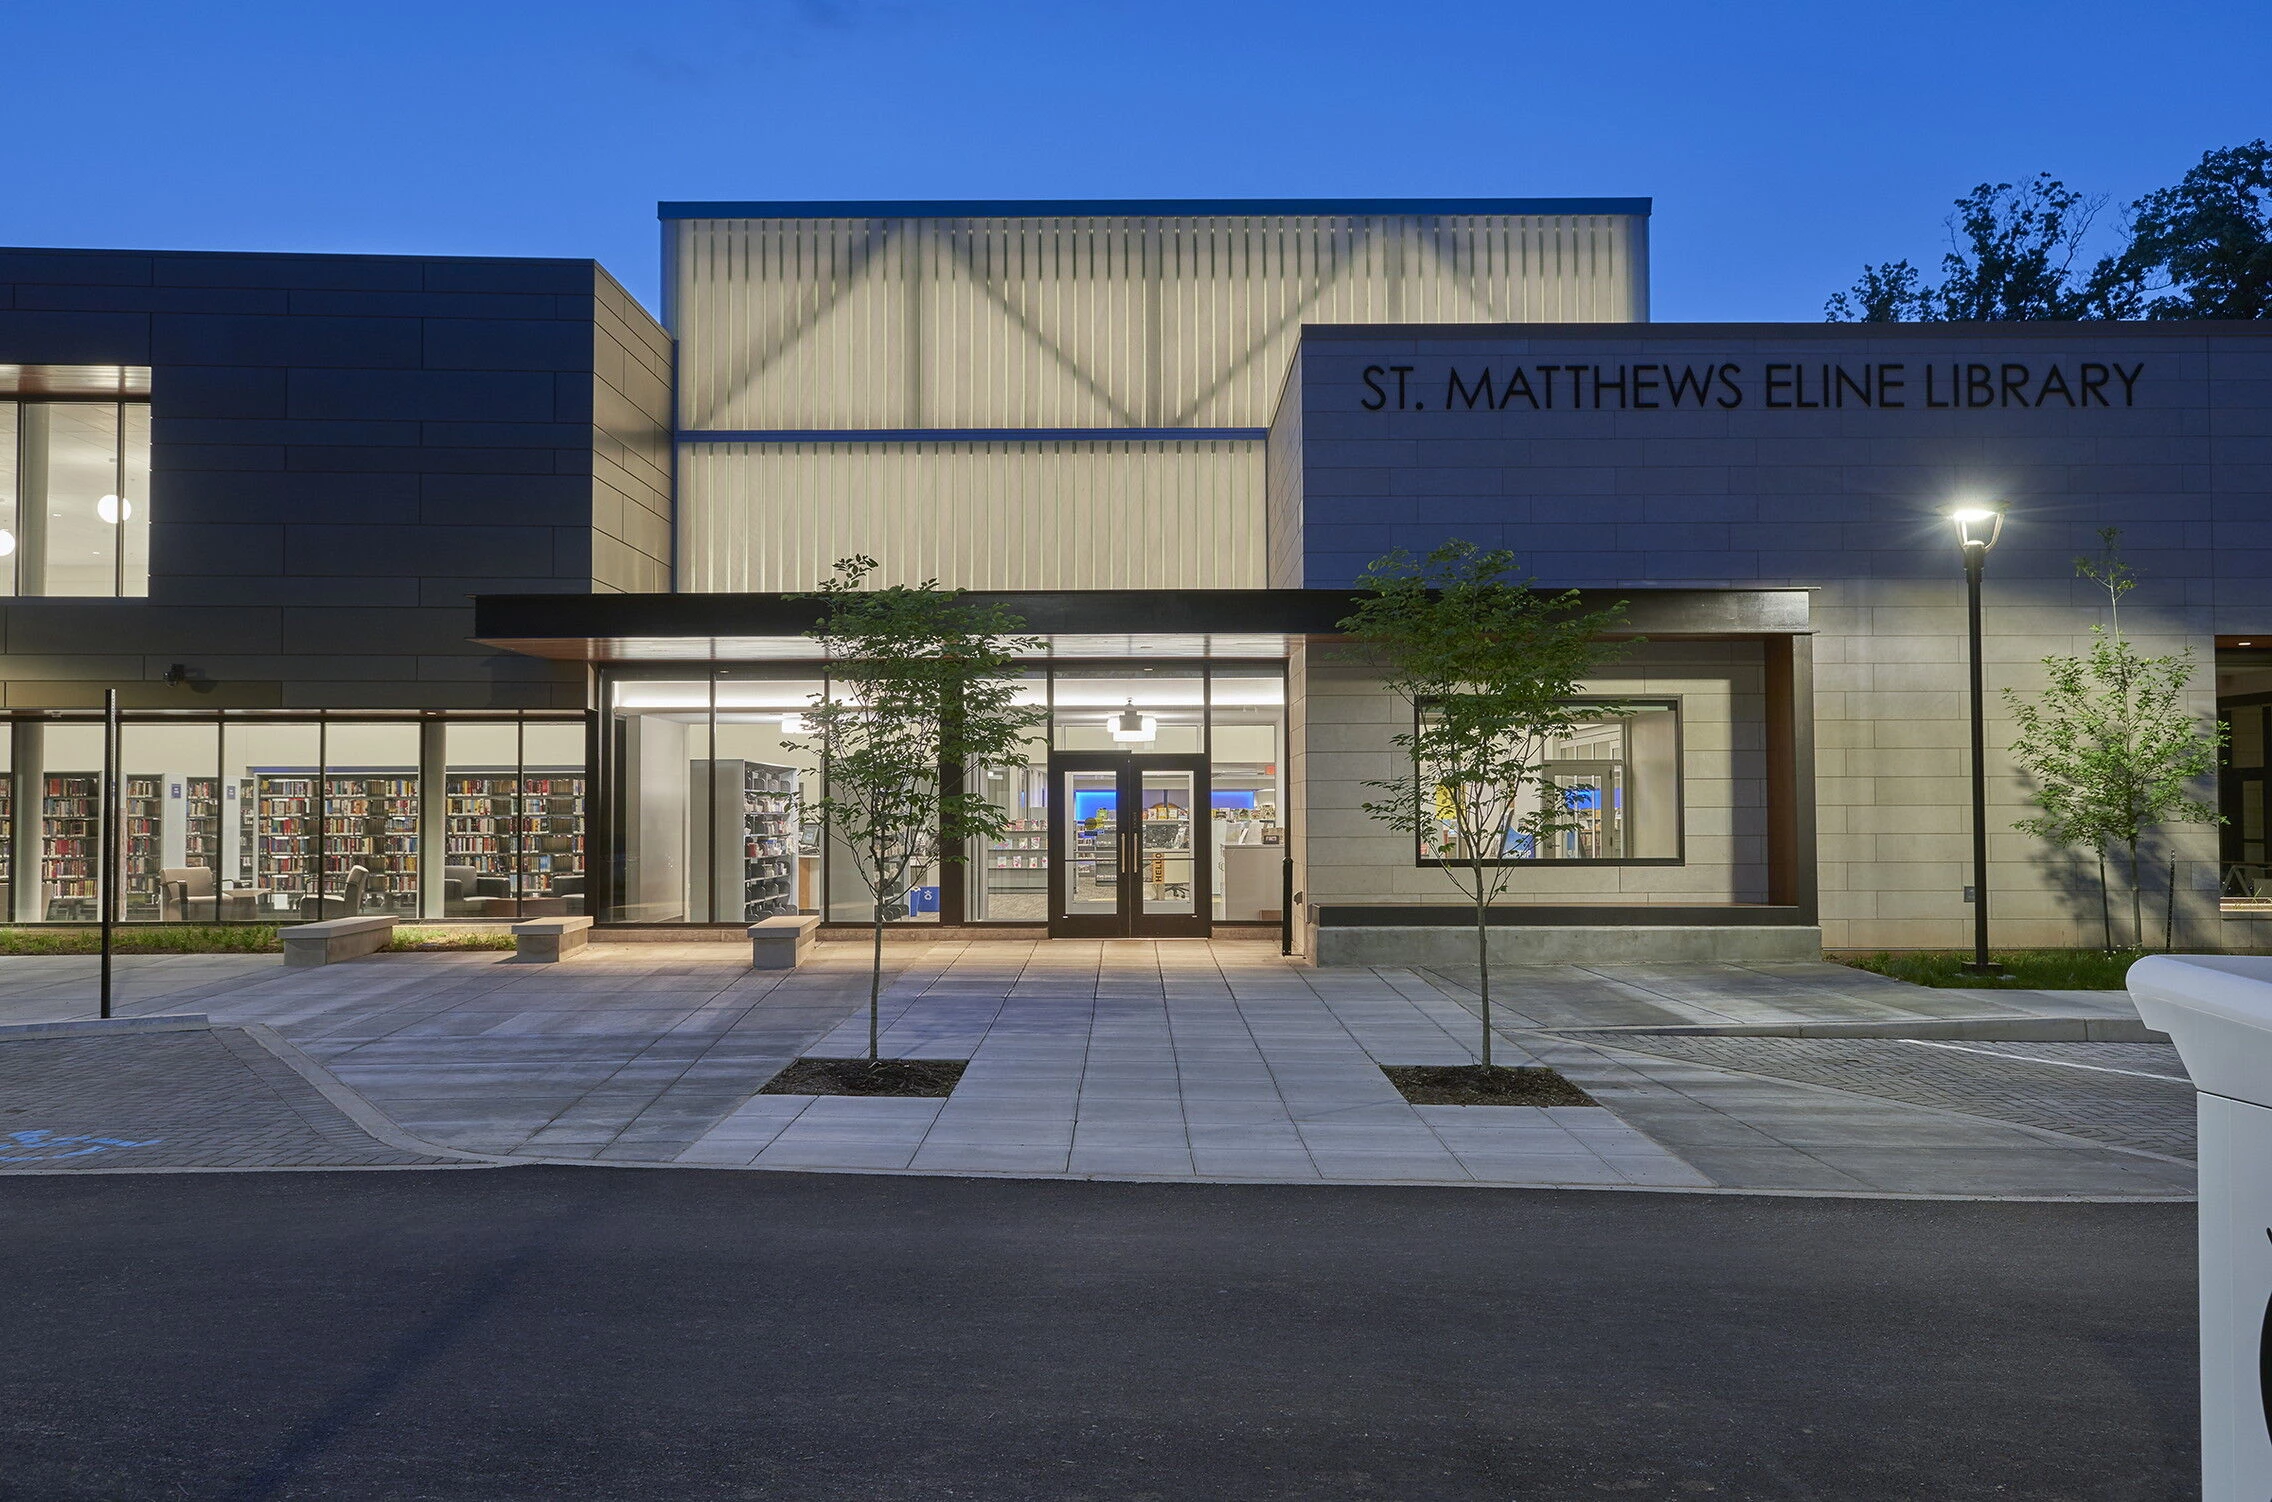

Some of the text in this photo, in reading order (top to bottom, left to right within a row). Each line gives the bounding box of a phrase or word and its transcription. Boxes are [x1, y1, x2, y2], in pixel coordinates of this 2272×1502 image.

[1360, 363, 2145, 412] ST. MATTHEWS ELINE LIBRARY
